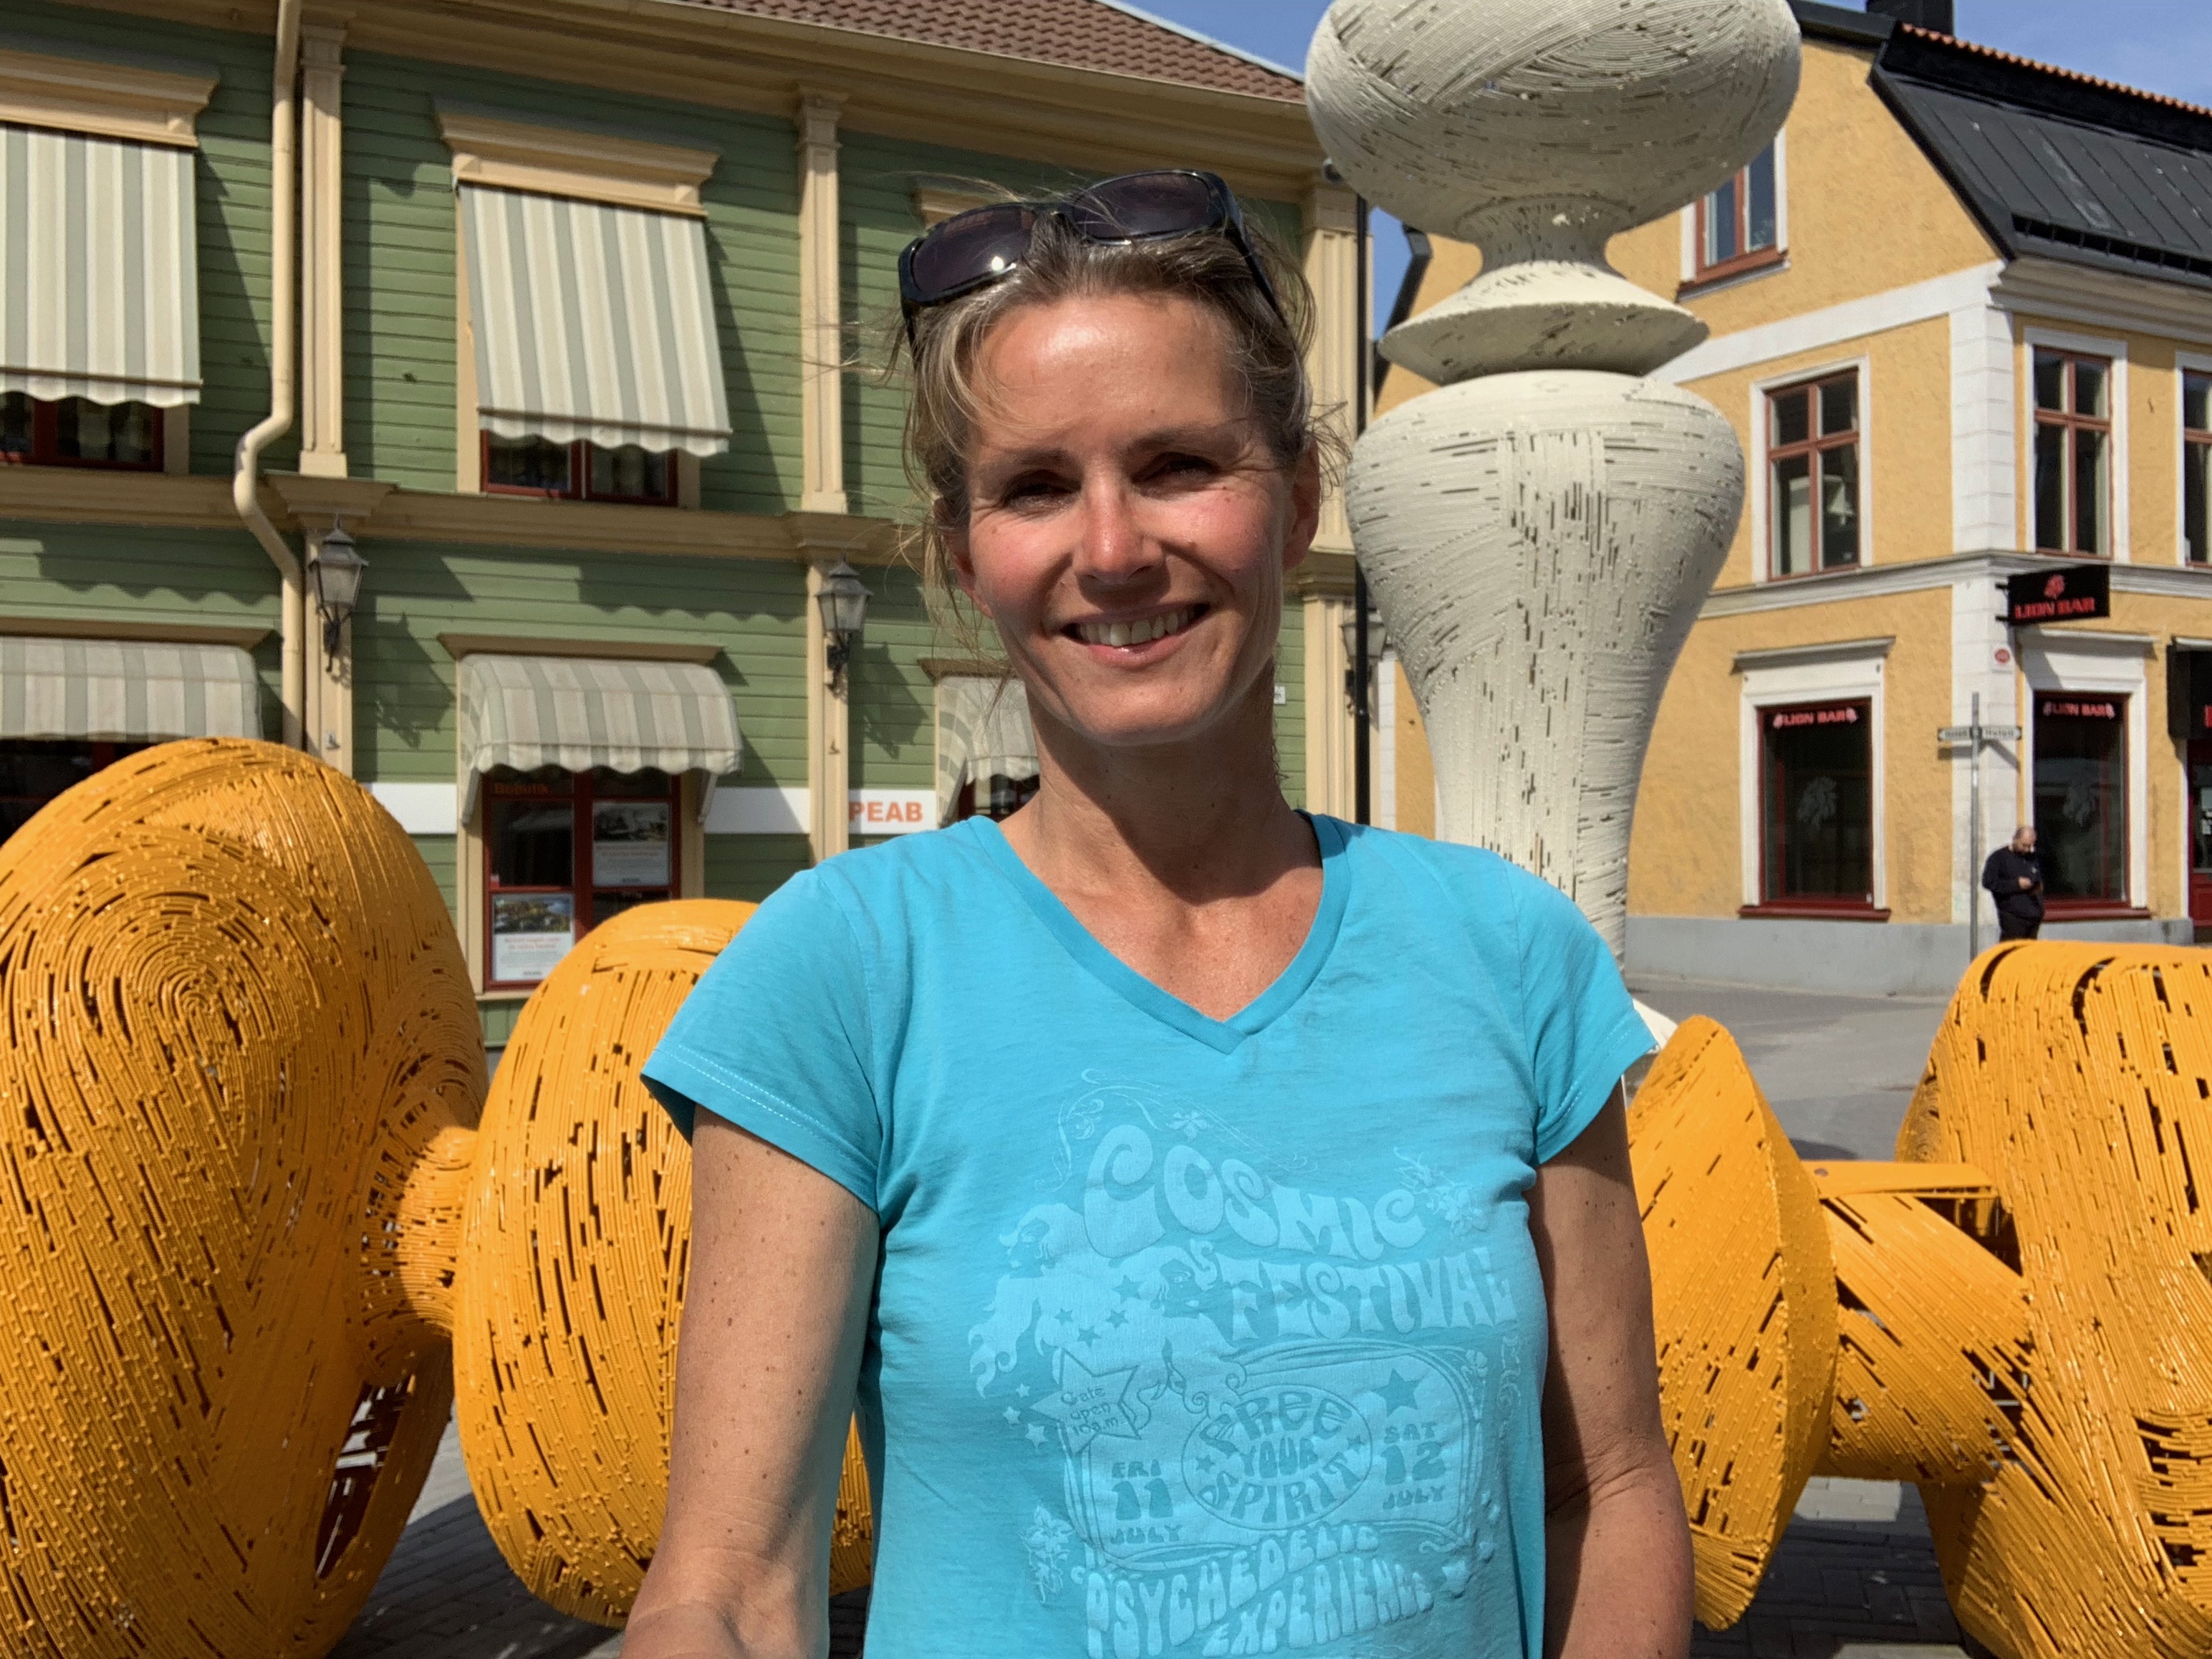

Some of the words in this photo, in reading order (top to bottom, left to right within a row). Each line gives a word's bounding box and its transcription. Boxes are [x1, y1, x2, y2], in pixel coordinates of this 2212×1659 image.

[2014, 602, 2055, 620] LION
[2057, 597, 2095, 615] BAR
[1817, 709, 1845, 723] BAR
[848, 801, 923, 823] PEAB
[1084, 1123, 1427, 1261] COSMIC
[1218, 1246, 1518, 1340] FESTIVAL
[1061, 1387, 1106, 1406] Gate
[1069, 1402, 1111, 1424] open
[1199, 1391, 1353, 1458] FREE
[1383, 1421, 1437, 1444] SAT
[1111, 1458, 1162, 1478] FRI
[1240, 1437, 1318, 1478] YOUR
[1380, 1441, 1447, 1486] 12
[1111, 1478, 1174, 1521] 11
[1196, 1451, 1360, 1524] SPIRIT
[1382, 1484, 1446, 1510] JULY
[1110, 1524, 1183, 1544] JULY
[1085, 1524, 1378, 1659] PSYCHEDELIC
[1202, 1556, 1433, 1658] EXPERIENCE
